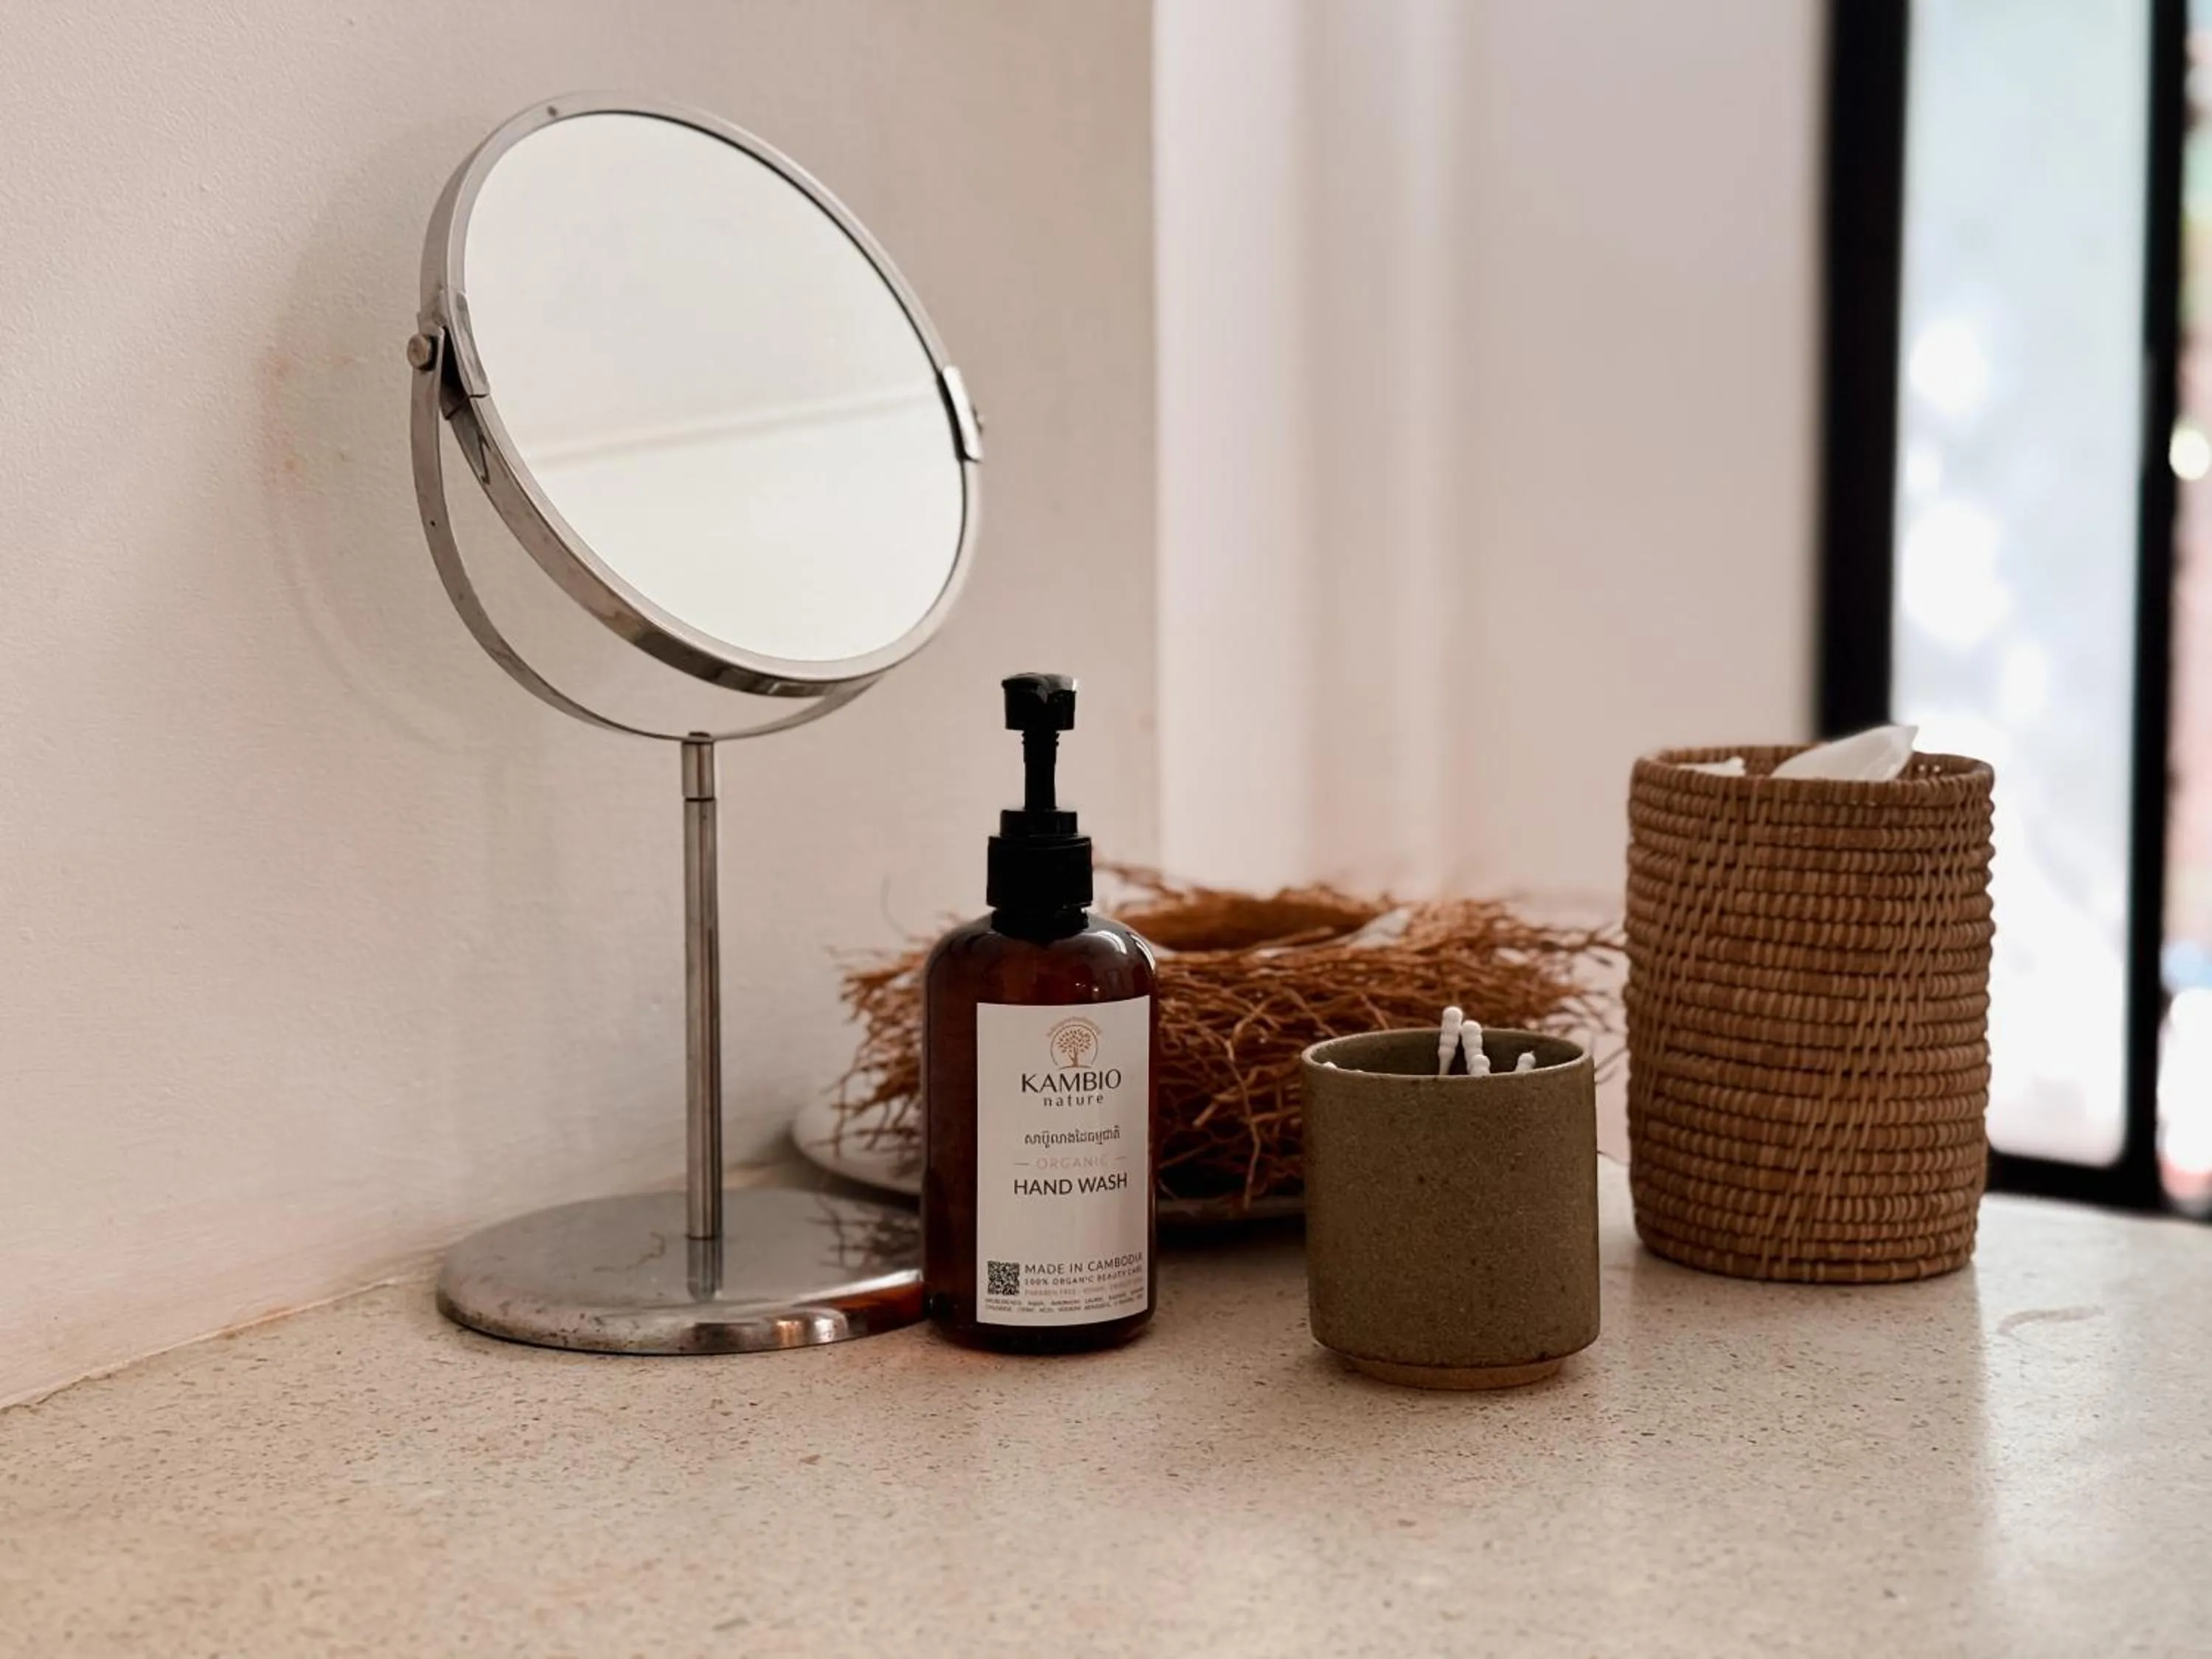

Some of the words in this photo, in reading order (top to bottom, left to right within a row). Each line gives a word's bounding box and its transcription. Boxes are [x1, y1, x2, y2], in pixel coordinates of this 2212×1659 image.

[1021, 1068, 1121, 1093] KAMBIO
[1043, 1093, 1104, 1107] nature
[1035, 1153, 1109, 1170] ORGANIC
[1014, 1178, 1073, 1195] HAND
[1077, 1172, 1127, 1194] WASH
[1024, 1262, 1065, 1275] MADE
[1069, 1262, 1083, 1273] IN
[1024, 1277, 1048, 1286] 100%
[1052, 1275, 1094, 1285] ORGANIC
